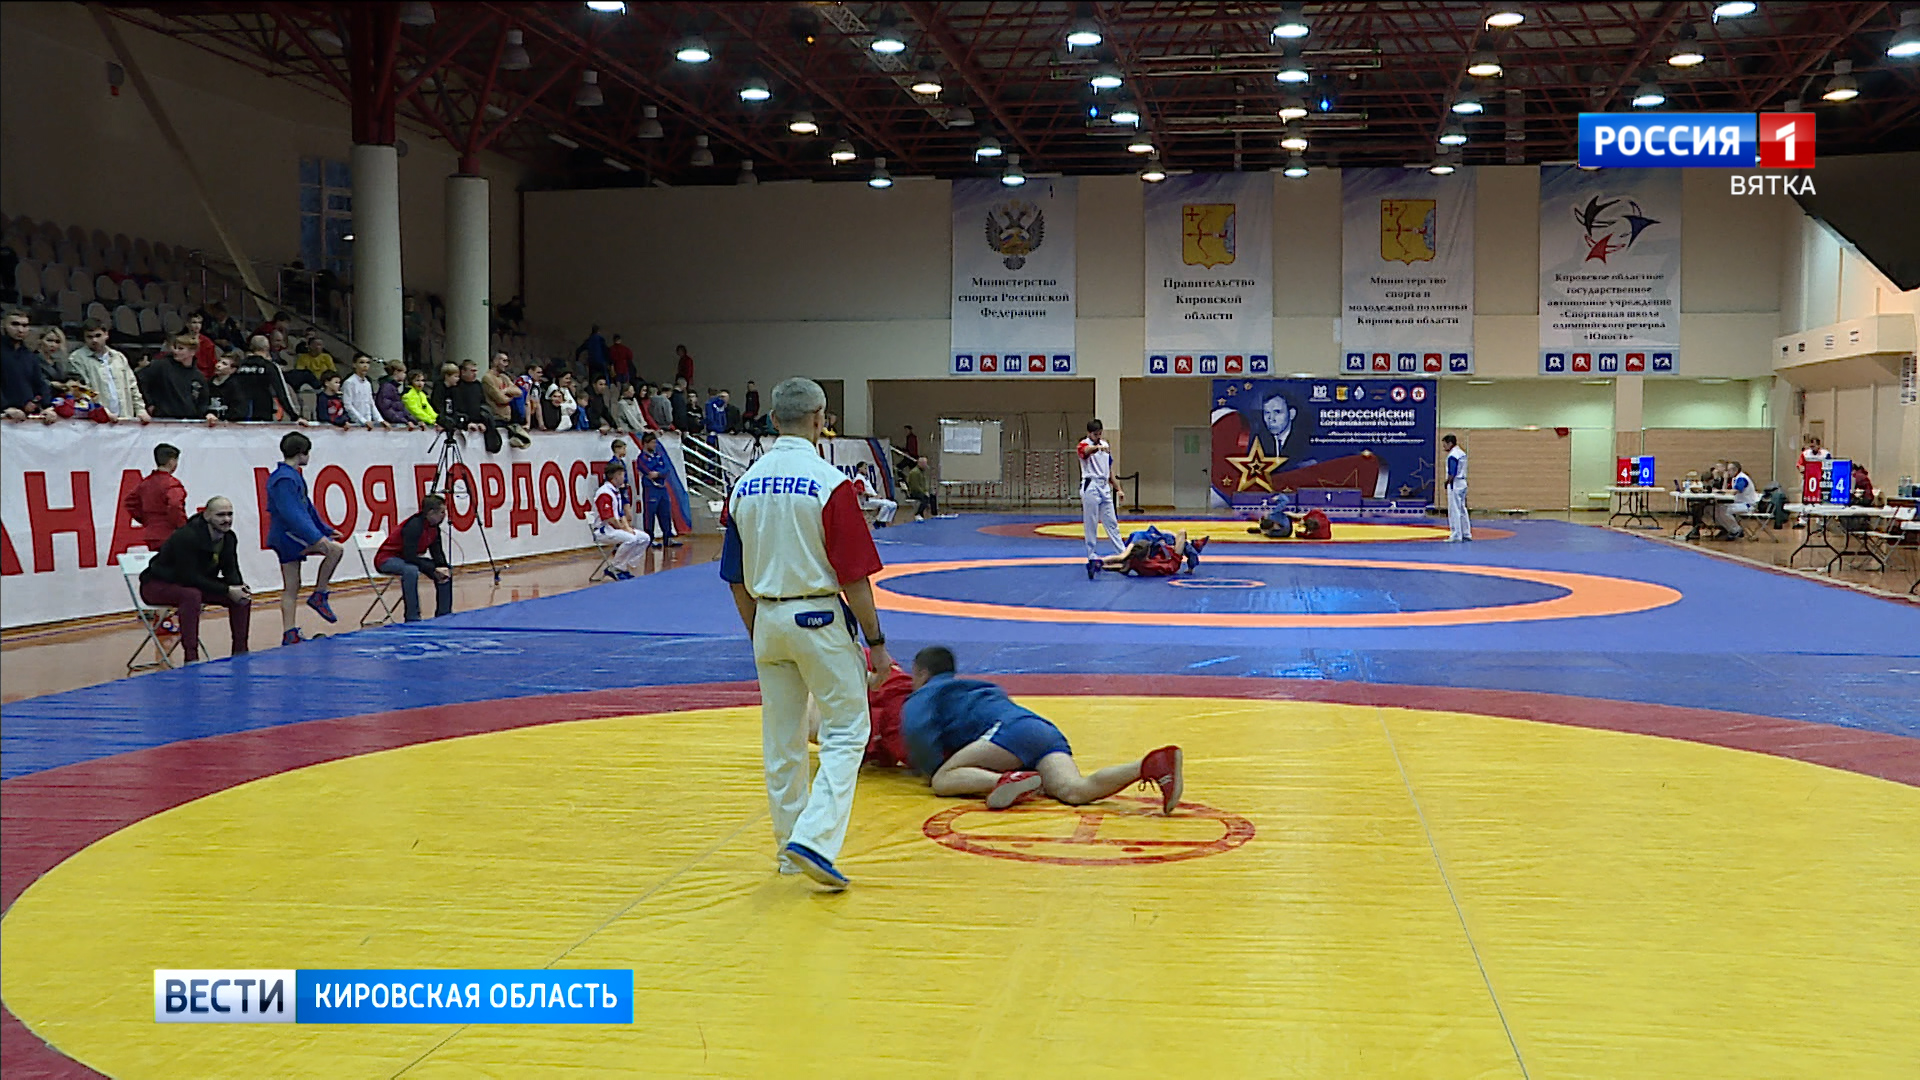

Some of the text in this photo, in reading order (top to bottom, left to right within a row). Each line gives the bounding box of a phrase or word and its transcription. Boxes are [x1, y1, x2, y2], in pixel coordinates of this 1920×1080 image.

[972, 277, 1057, 287] Министерство
[1163, 277, 1255, 289] Правительство
[1370, 277, 1447, 287] Министерство
[1555, 272, 1664, 283] Кировское областное
[1385, 291, 1422, 300] спорта
[1566, 286, 1652, 296] государственное
[958, 293, 1070, 304] спорта Российской
[1176, 295, 1242, 306] Кировской
[1609, 299, 1672, 308] учреждение
[980, 307, 1047, 319] Федерации
[1416, 304, 1468, 312] политики
[1184, 311, 1233, 320] области
[1357, 315, 1459, 326] Кировской области
[1320, 407, 1415, 419] ВСЕРОССИЙСКИЕ
[1642, 467, 1650, 478] 0
[736, 476, 822, 498] REFEREE
[1808, 477, 1817, 492] 0
[1835, 477, 1845, 493] 4
